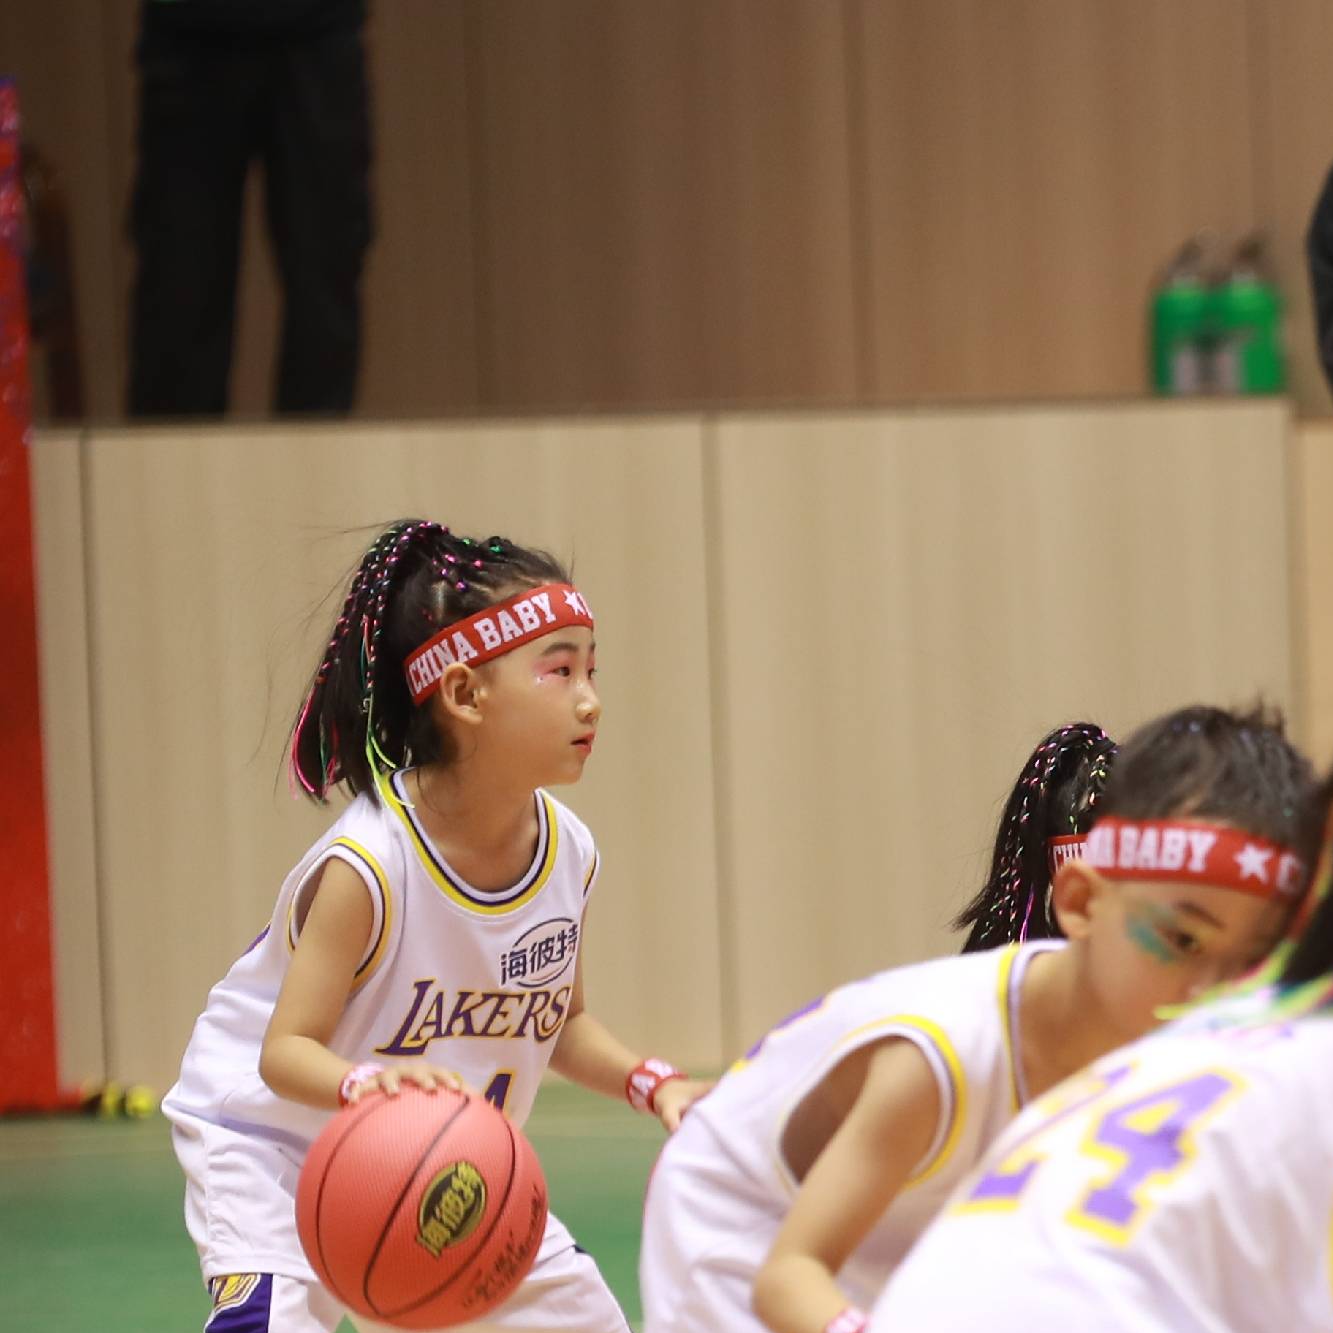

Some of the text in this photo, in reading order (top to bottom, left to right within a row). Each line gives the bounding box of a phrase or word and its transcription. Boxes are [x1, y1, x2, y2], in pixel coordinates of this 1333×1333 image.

[408, 631, 478, 694] CHINA
[473, 592, 557, 651] BABY
[1117, 825, 1217, 873] BABY
[500, 924, 579, 986] 海彼特
[373, 976, 573, 1059] LAKERS
